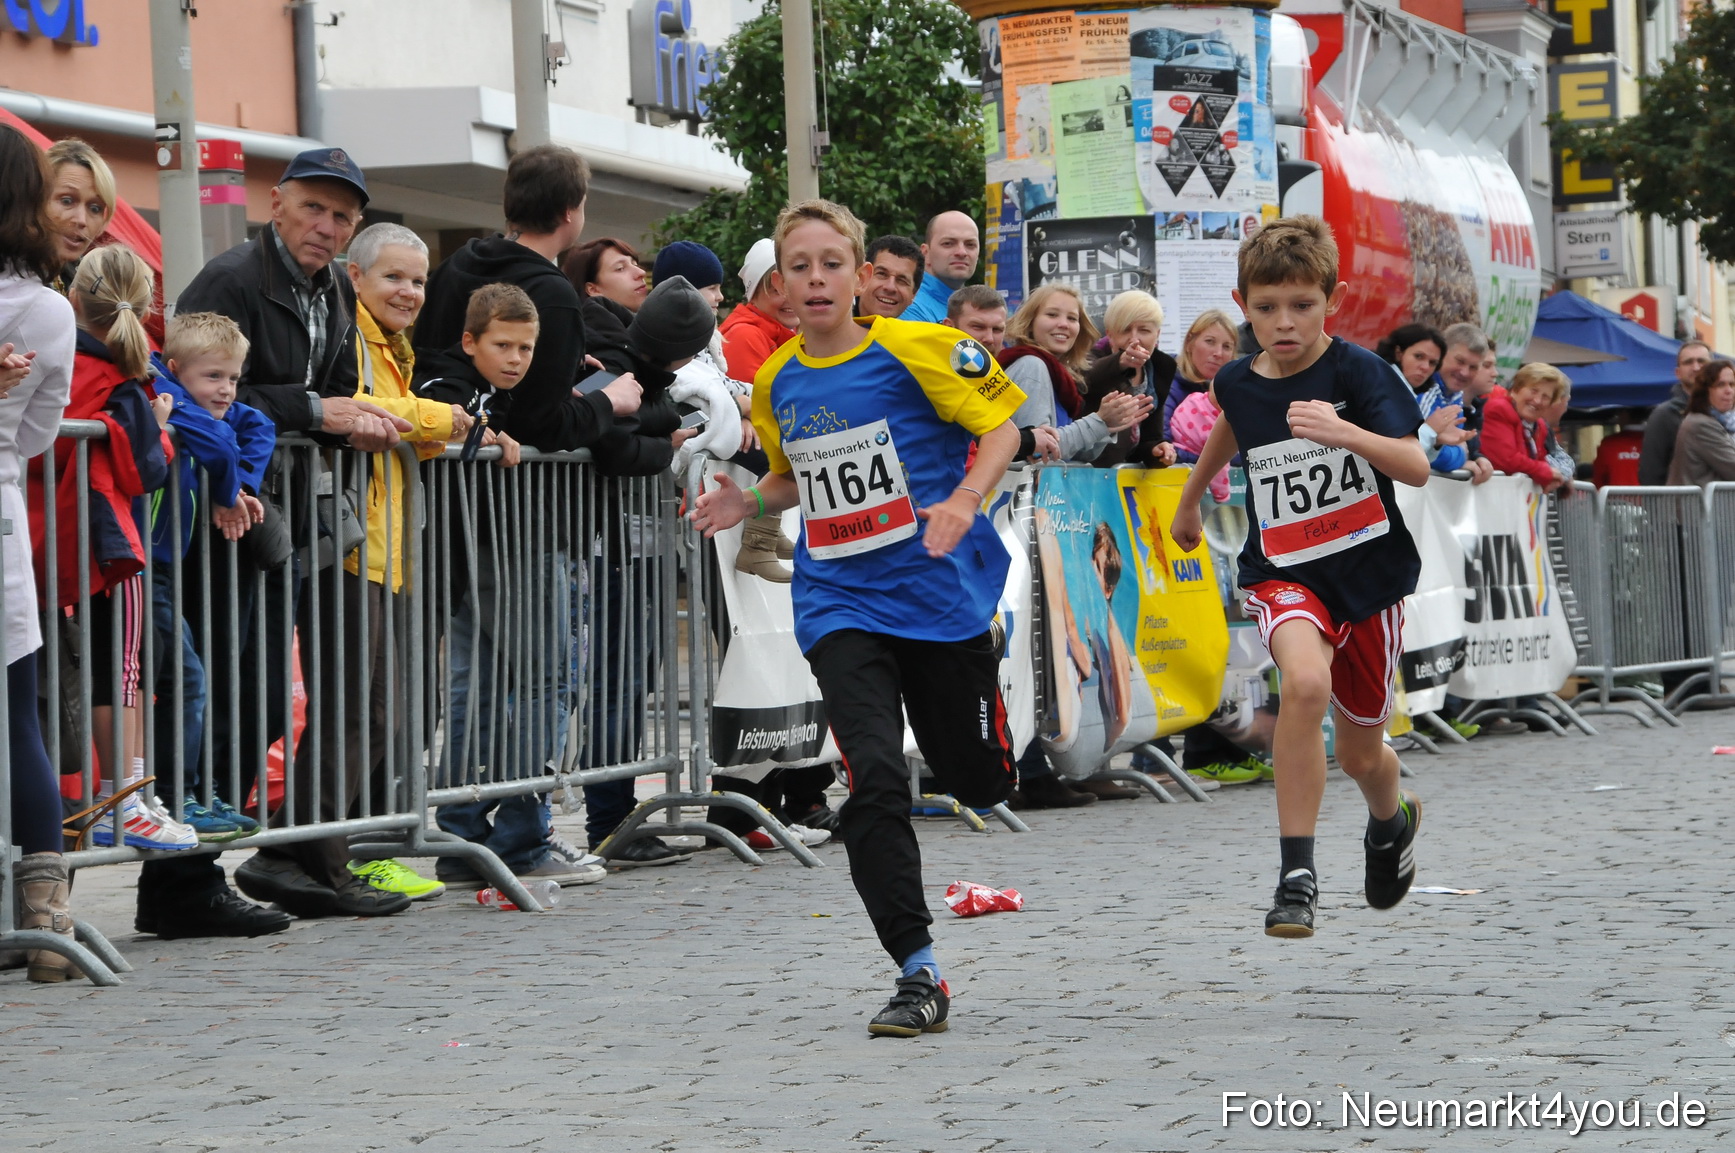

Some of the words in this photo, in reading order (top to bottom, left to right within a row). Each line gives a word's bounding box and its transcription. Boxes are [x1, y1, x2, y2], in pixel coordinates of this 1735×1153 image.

[1013, 15, 1073, 29] NEUMARKTER
[1080, 19, 1095, 27] 38.
[1098, 17, 1128, 26] NEUM
[1080, 27, 1128, 38] FRÜHLIN
[654, 0, 722, 119] frie
[1183, 72, 1213, 86] JAZZ
[1560, 216, 1619, 227] Altstadthotel
[1486, 205, 1536, 270] AVIA
[1567, 231, 1611, 245] Stern
[1039, 248, 1140, 274] GLENN
[1485, 275, 1534, 346] Pellets
[789, 452, 813, 464] PARTL
[813, 439, 871, 461] Neumarkt
[1249, 457, 1282, 473] PARTL
[800, 453, 894, 513] 7164
[1260, 453, 1366, 520] 7524
[828, 515, 874, 540] David
[1303, 518, 1340, 540] Felix
[1140, 636, 1187, 654] Außenplatten
[979, 696, 988, 740] saller
